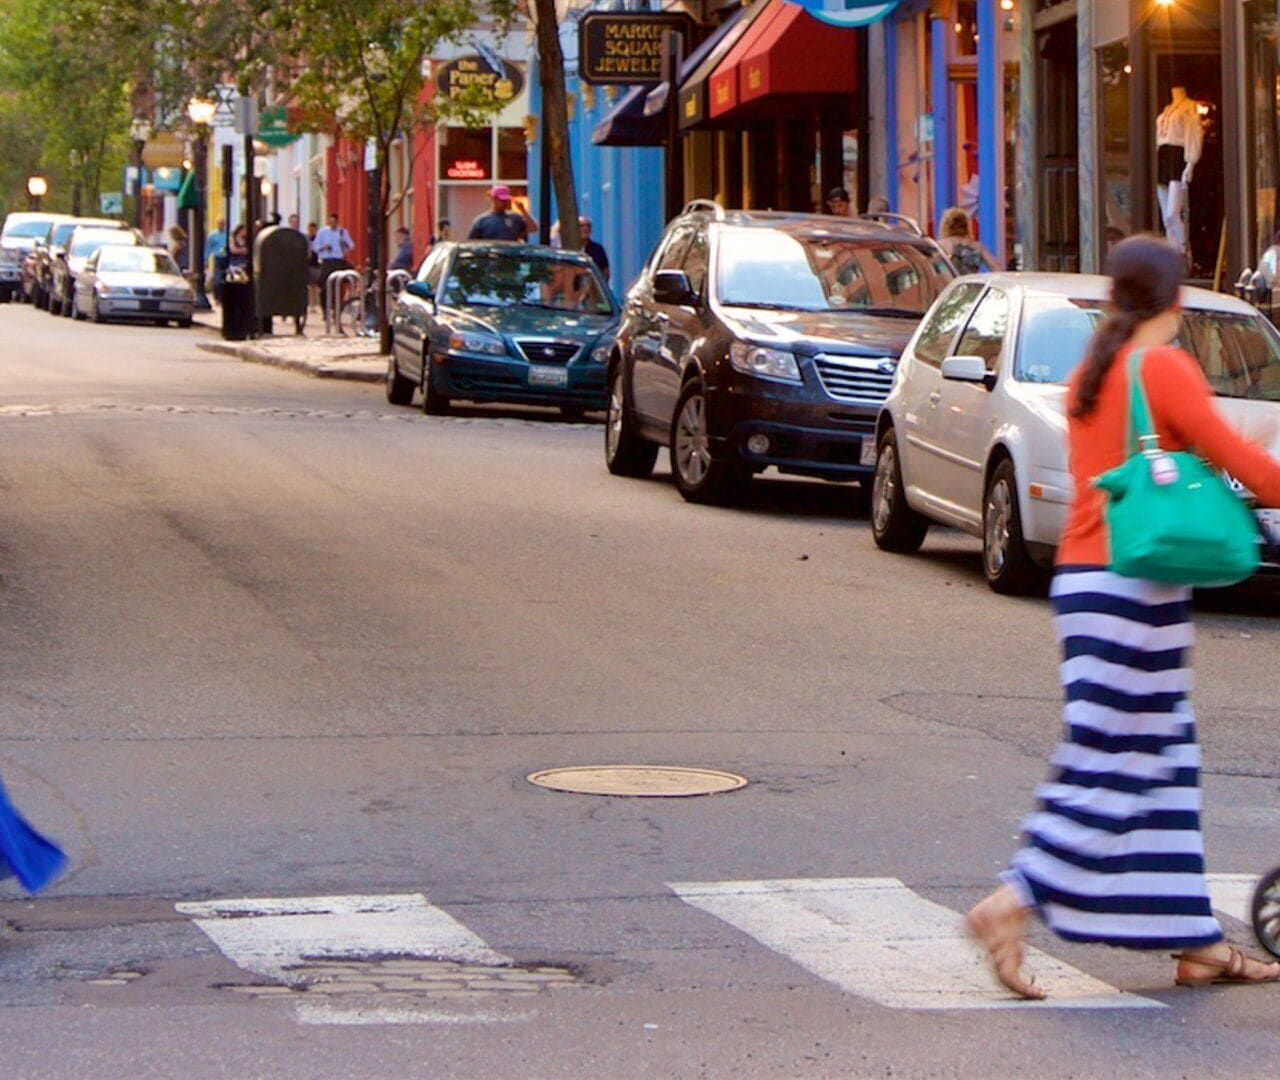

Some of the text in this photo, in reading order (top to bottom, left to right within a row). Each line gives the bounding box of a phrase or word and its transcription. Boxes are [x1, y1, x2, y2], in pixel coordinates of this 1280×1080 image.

[605, 24, 668, 39] MARKE
[605, 40, 662, 56] SQUAR
[594, 57, 661, 72] JEWELE
